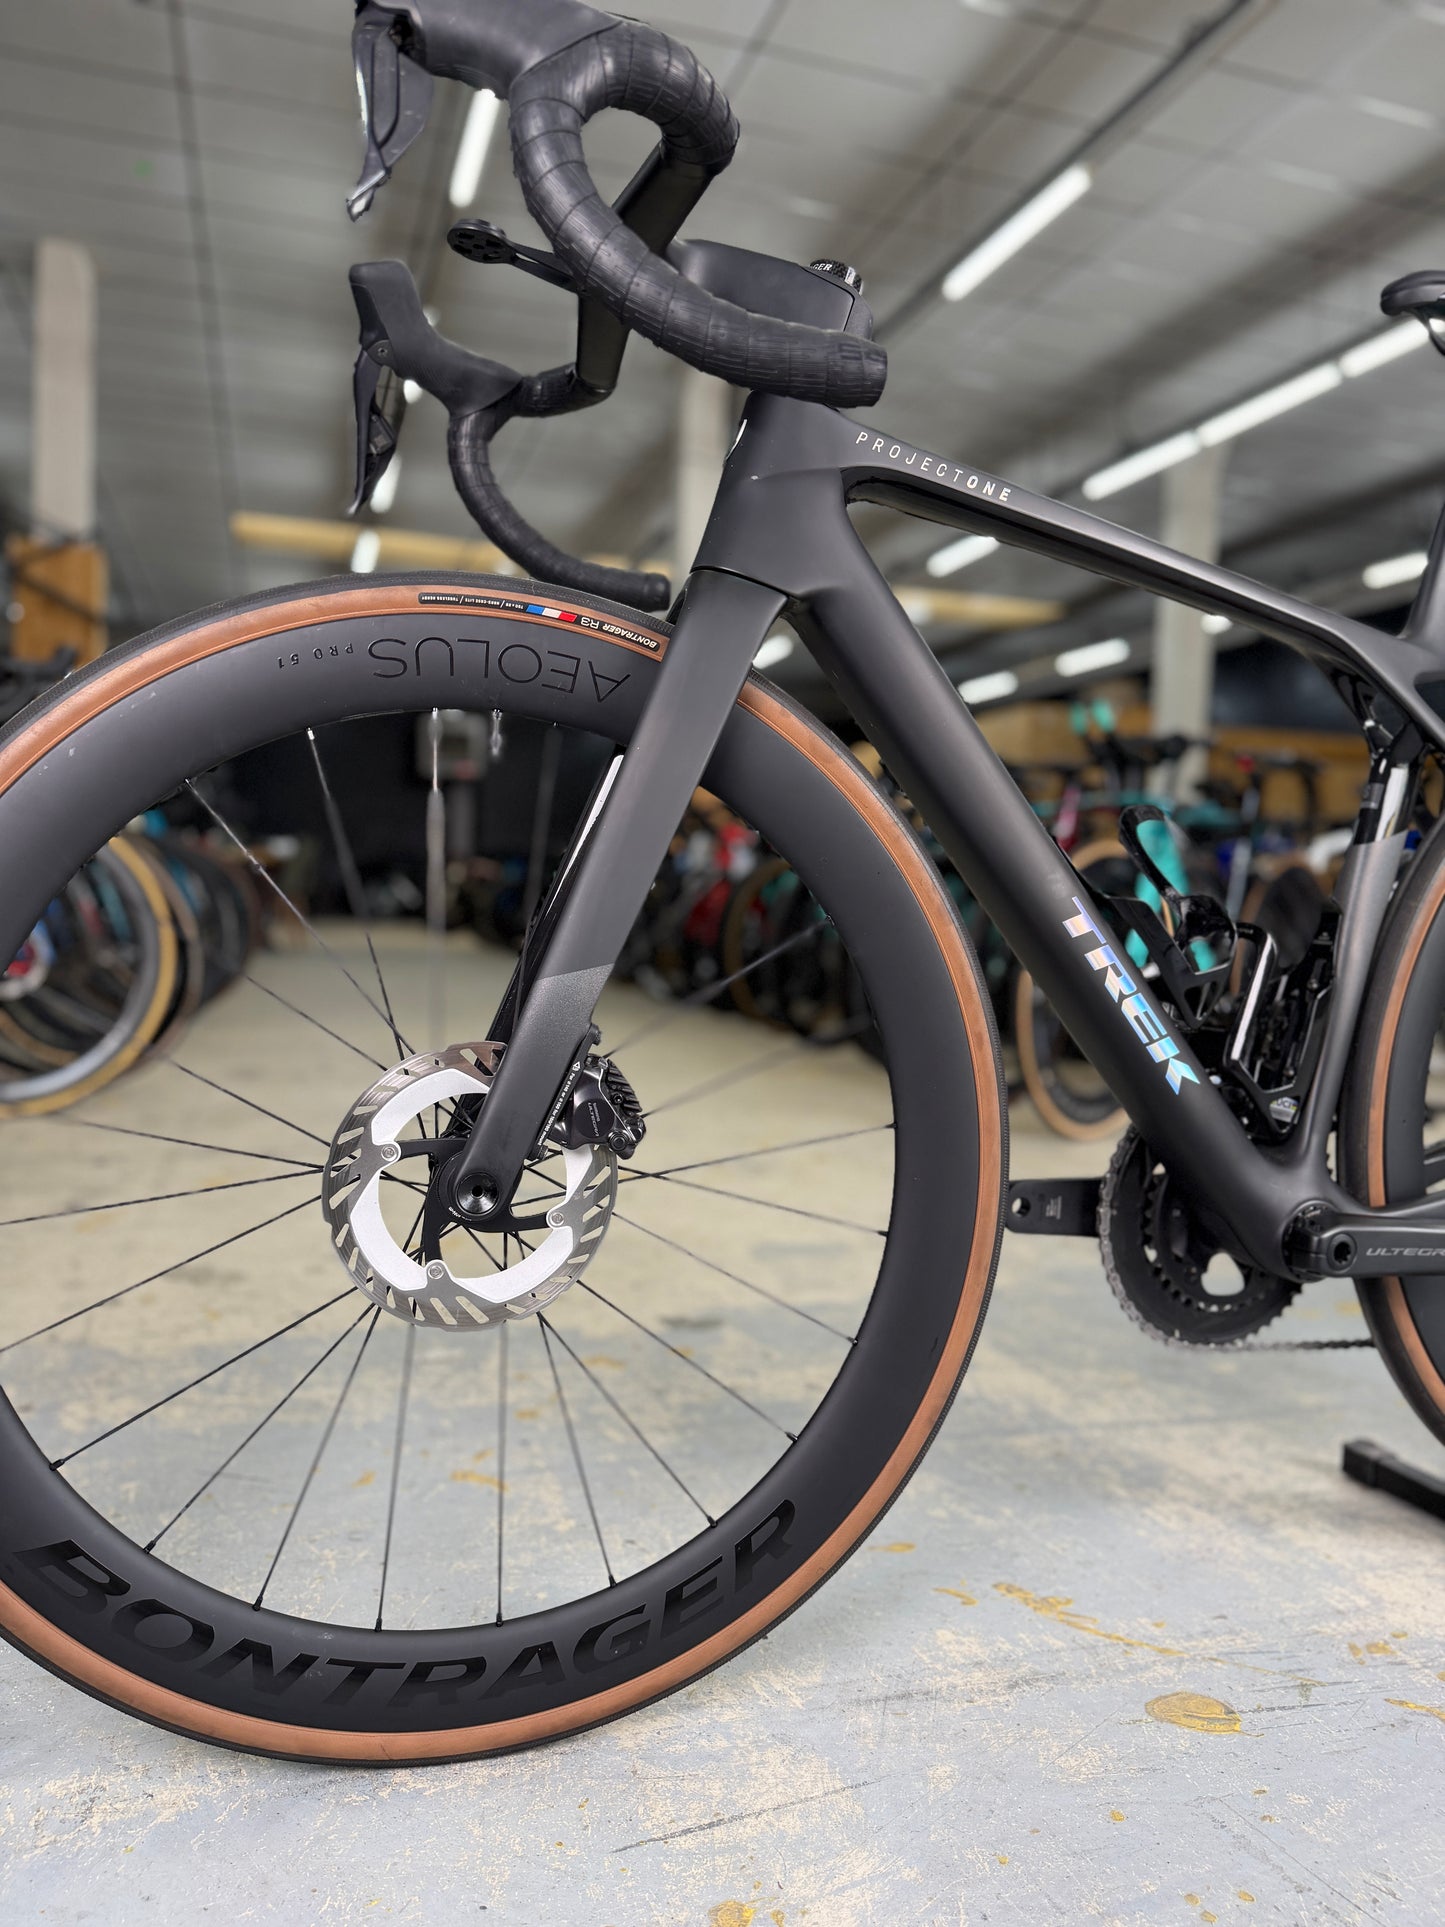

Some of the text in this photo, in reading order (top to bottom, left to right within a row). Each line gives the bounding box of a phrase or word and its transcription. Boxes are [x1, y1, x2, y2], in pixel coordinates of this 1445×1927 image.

[277, 638, 631, 702] AEOLUS PRO 51
[580, 616, 657, 648] BONTRAGER R3
[1062, 896, 1200, 1095] TREK
[13, 1498, 797, 1708] BONTRAGER
